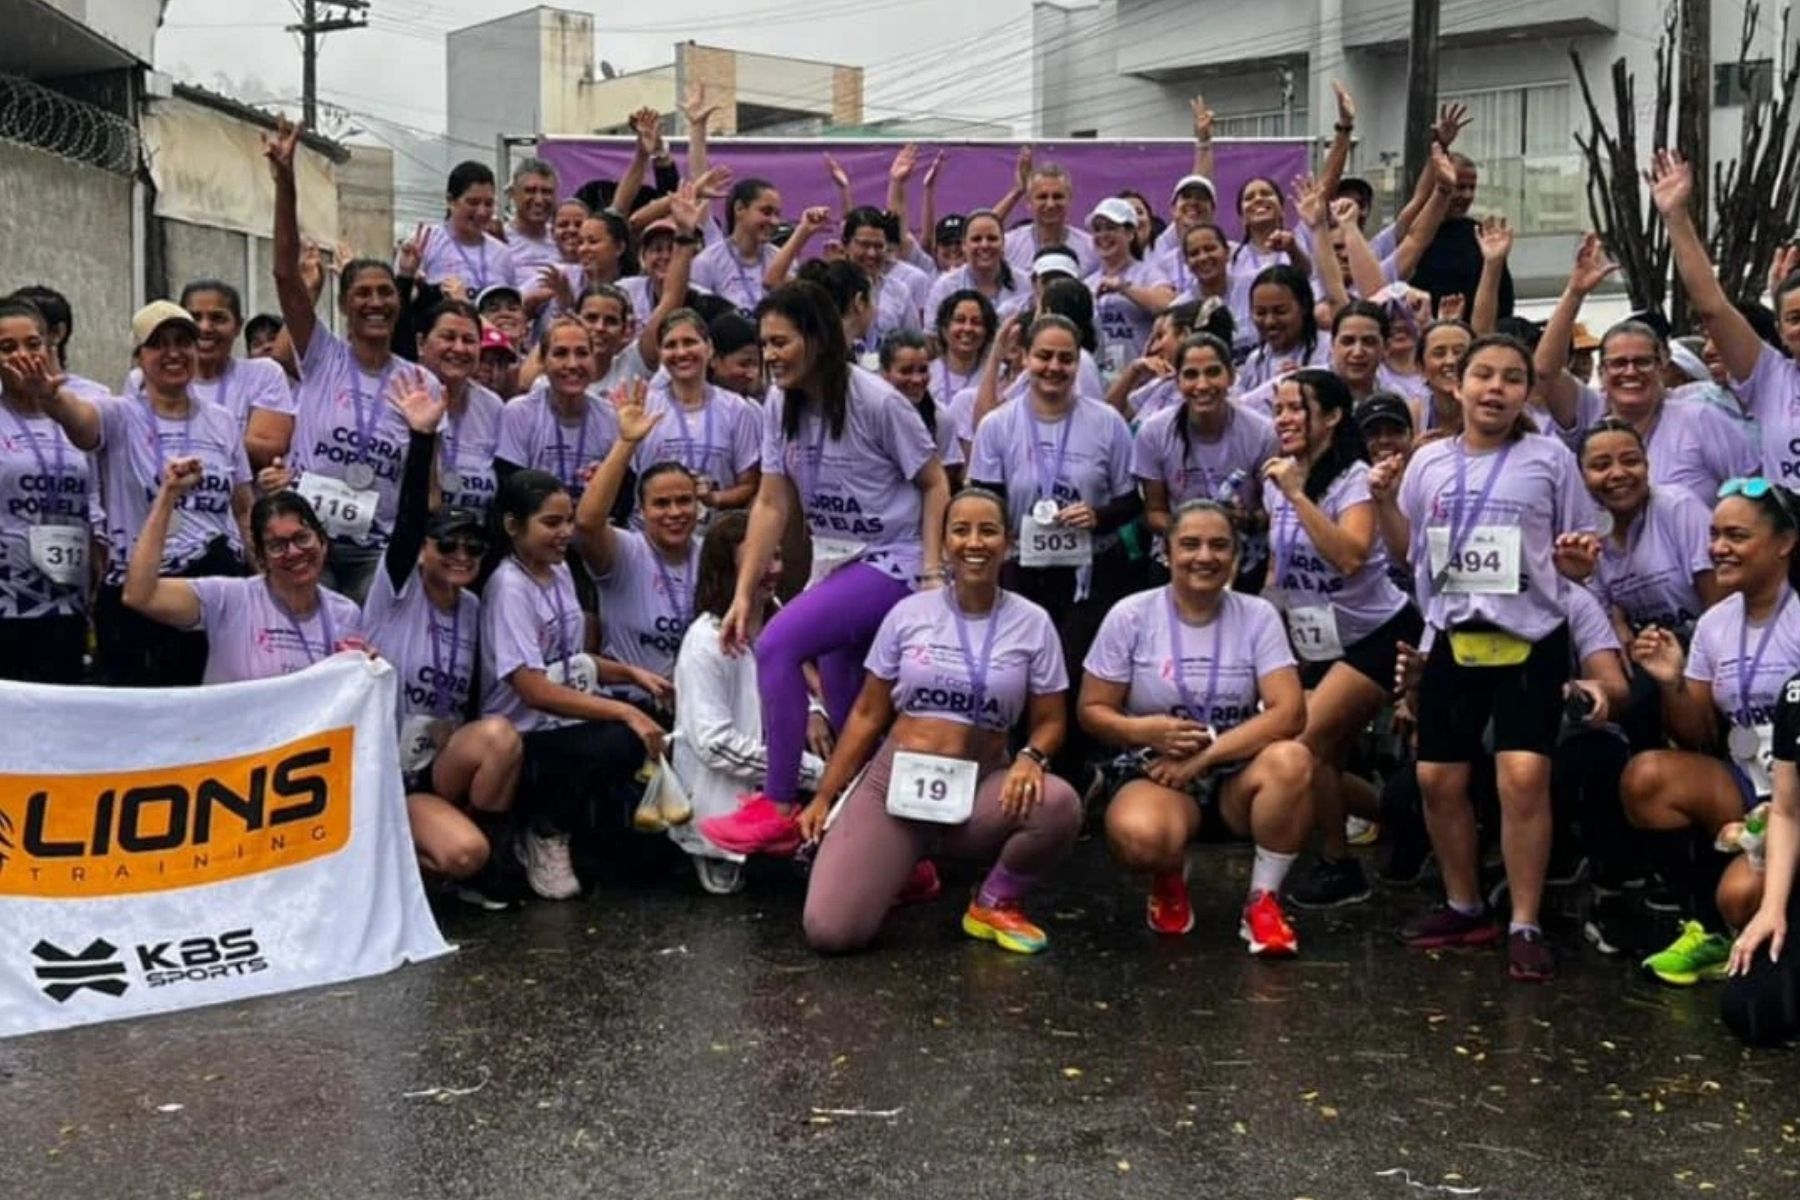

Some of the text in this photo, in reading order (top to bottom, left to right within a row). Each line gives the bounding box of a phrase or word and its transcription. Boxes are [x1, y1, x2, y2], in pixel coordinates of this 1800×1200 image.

[313, 495, 358, 521] 116
[1033, 532, 1078, 551] 503
[47, 545, 83, 568] 311
[1449, 550, 1502, 573] 494
[22, 747, 332, 858] LIONS
[914, 778, 949, 801] 19
[29, 825, 328, 883] TRAINING
[136, 928, 260, 972] KBS
[145, 956, 270, 989] SPORTS
